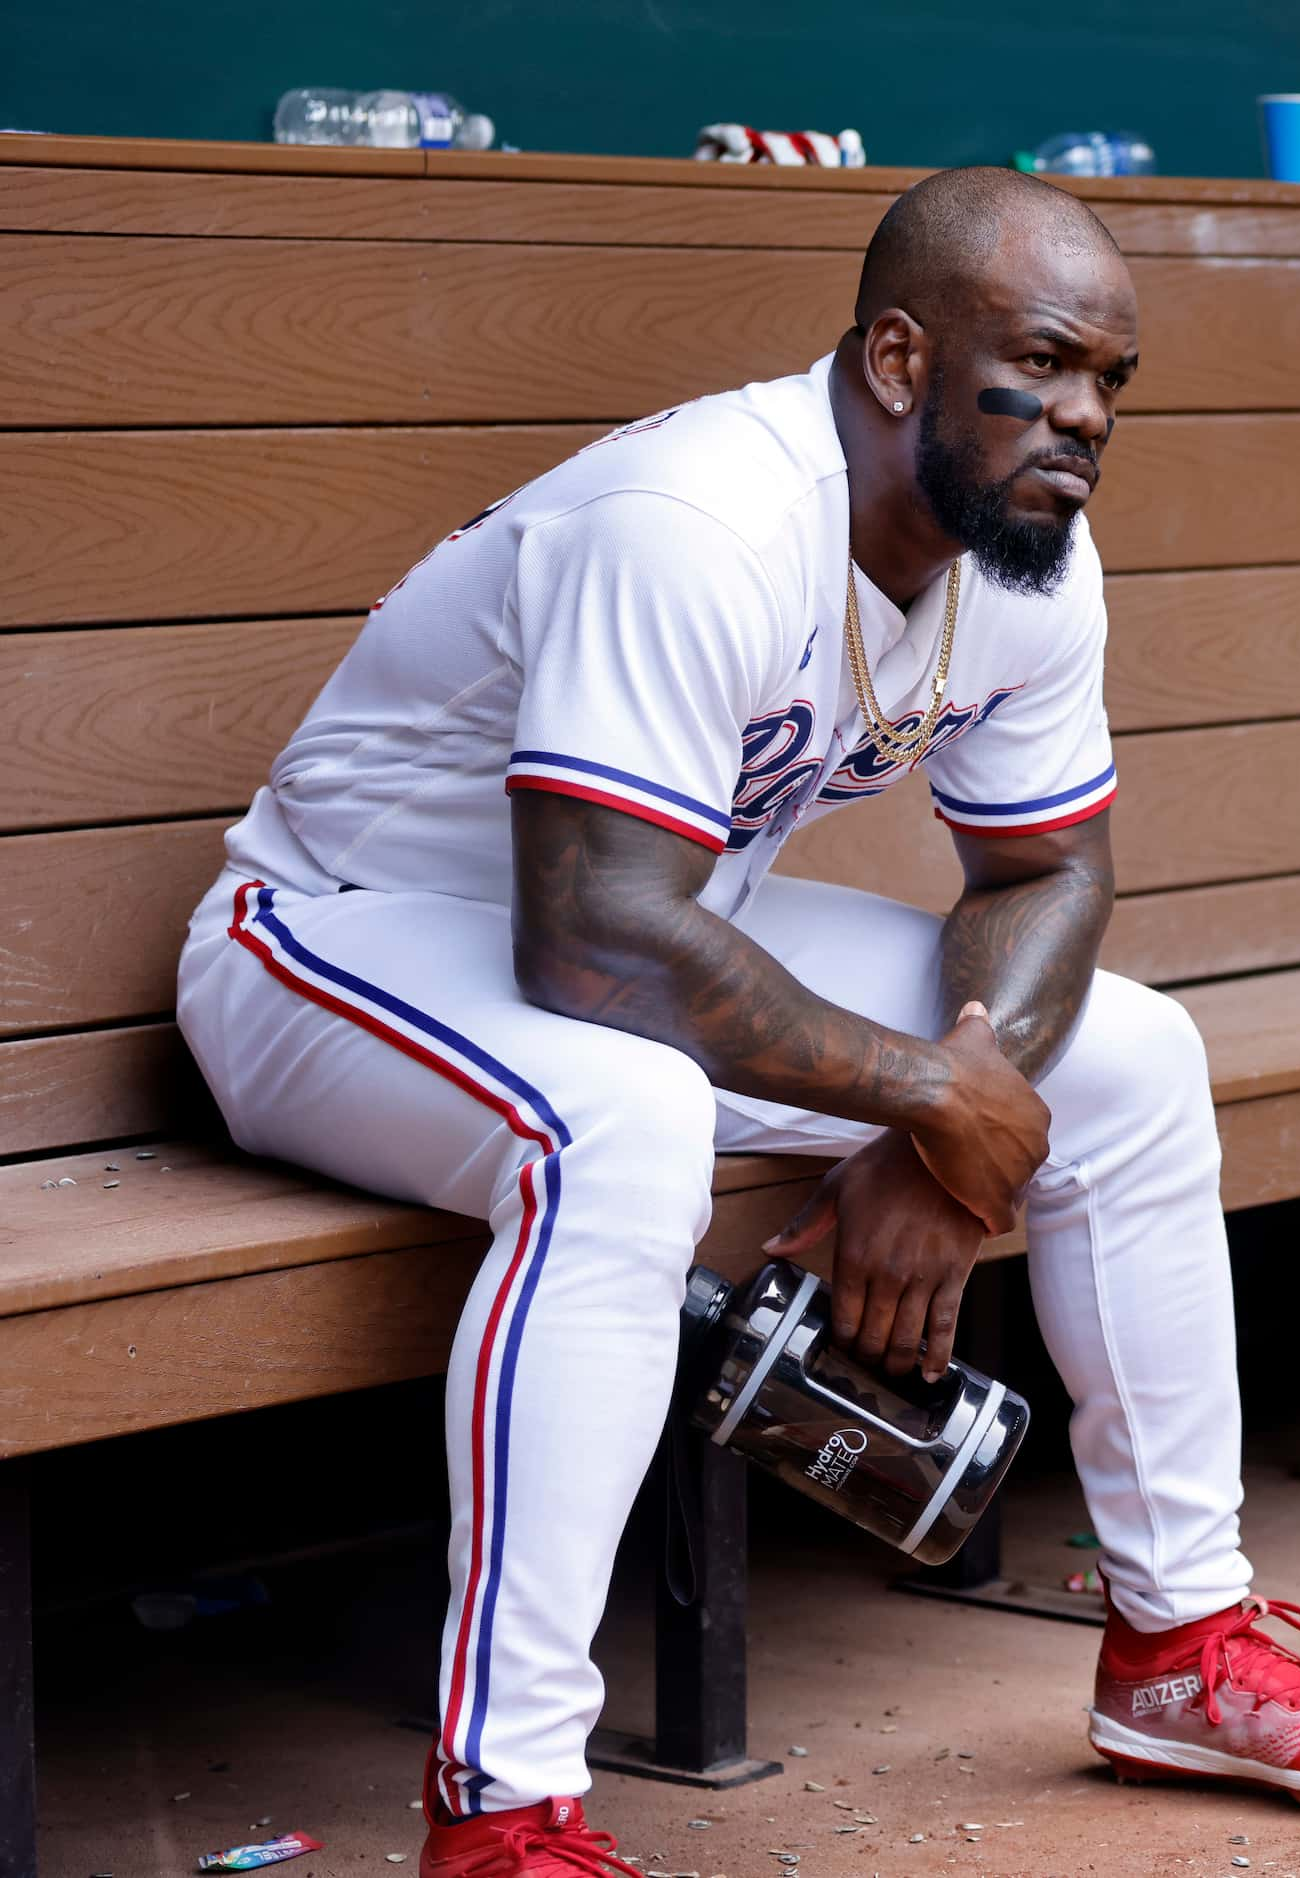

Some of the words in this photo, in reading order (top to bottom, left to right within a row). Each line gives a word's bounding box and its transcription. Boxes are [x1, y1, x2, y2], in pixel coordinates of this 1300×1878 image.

[806, 1435, 840, 1480] Hydro
[821, 1449, 853, 1489] MATE
[1132, 1674, 1203, 1711] ADIZER
